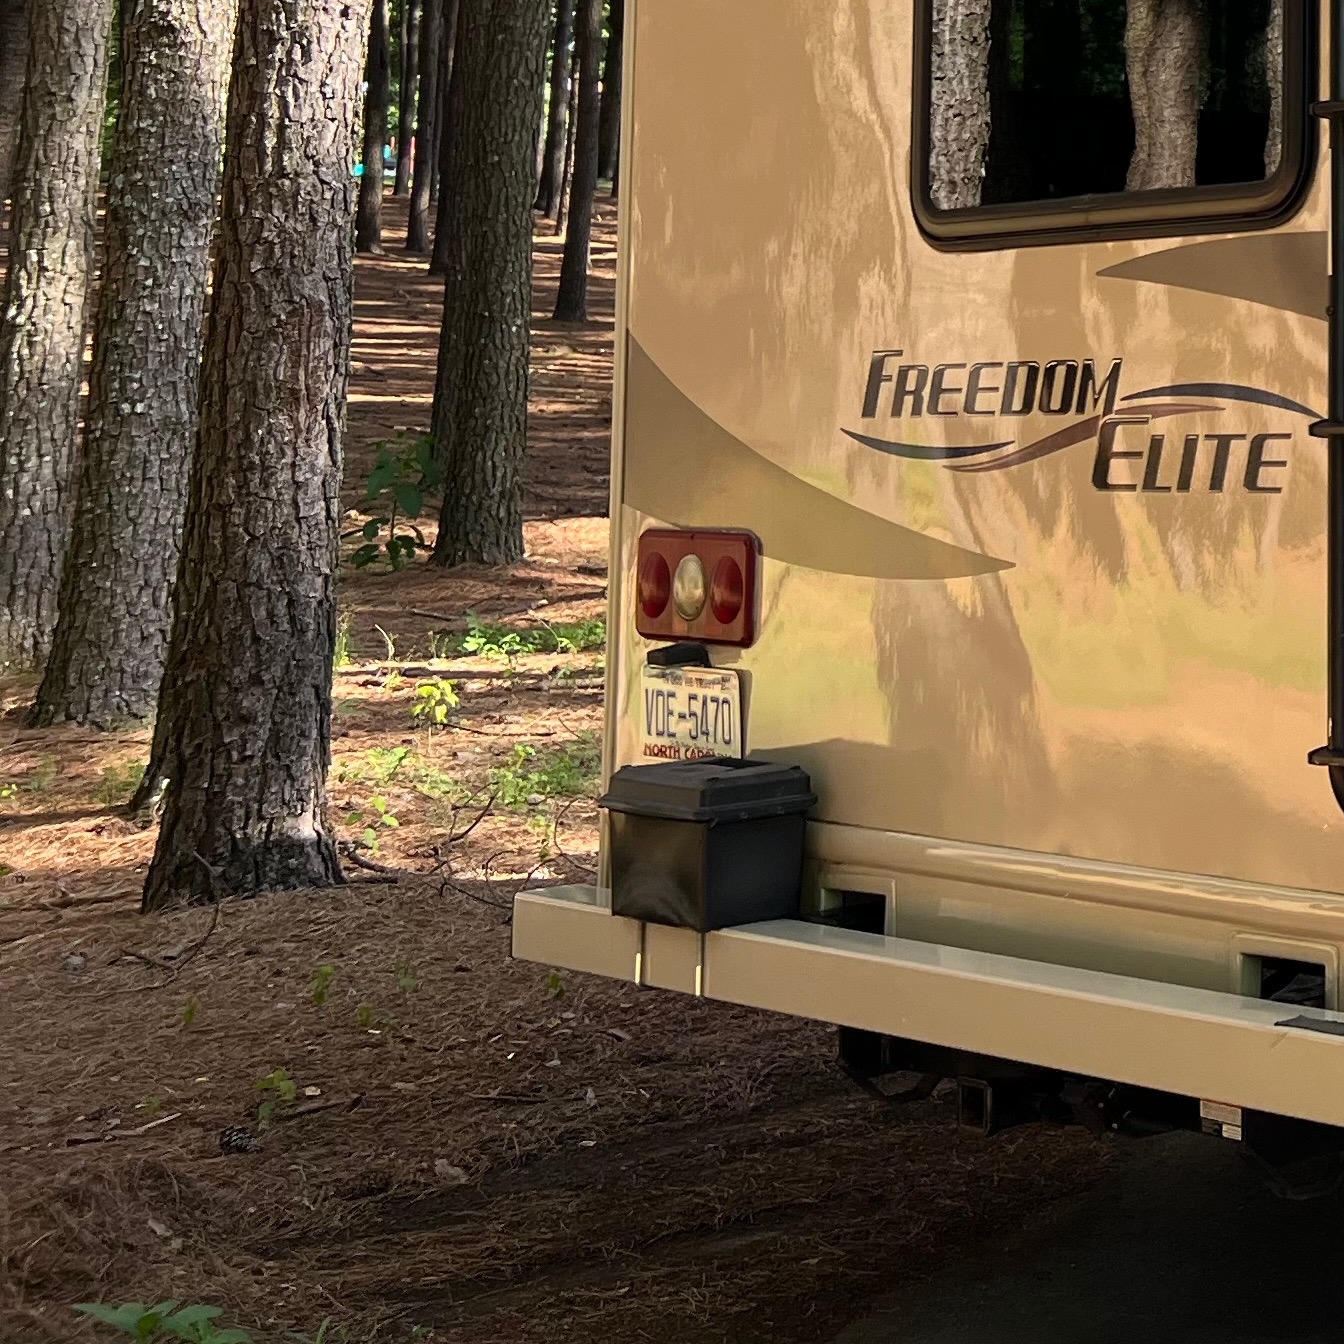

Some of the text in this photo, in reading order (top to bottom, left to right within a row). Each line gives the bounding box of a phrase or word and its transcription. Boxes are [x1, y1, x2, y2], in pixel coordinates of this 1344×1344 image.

[860, 349, 1123, 419] FREEDOM
[1091, 415, 1293, 494] ELITE
[643, 742, 681, 760] NORTH
